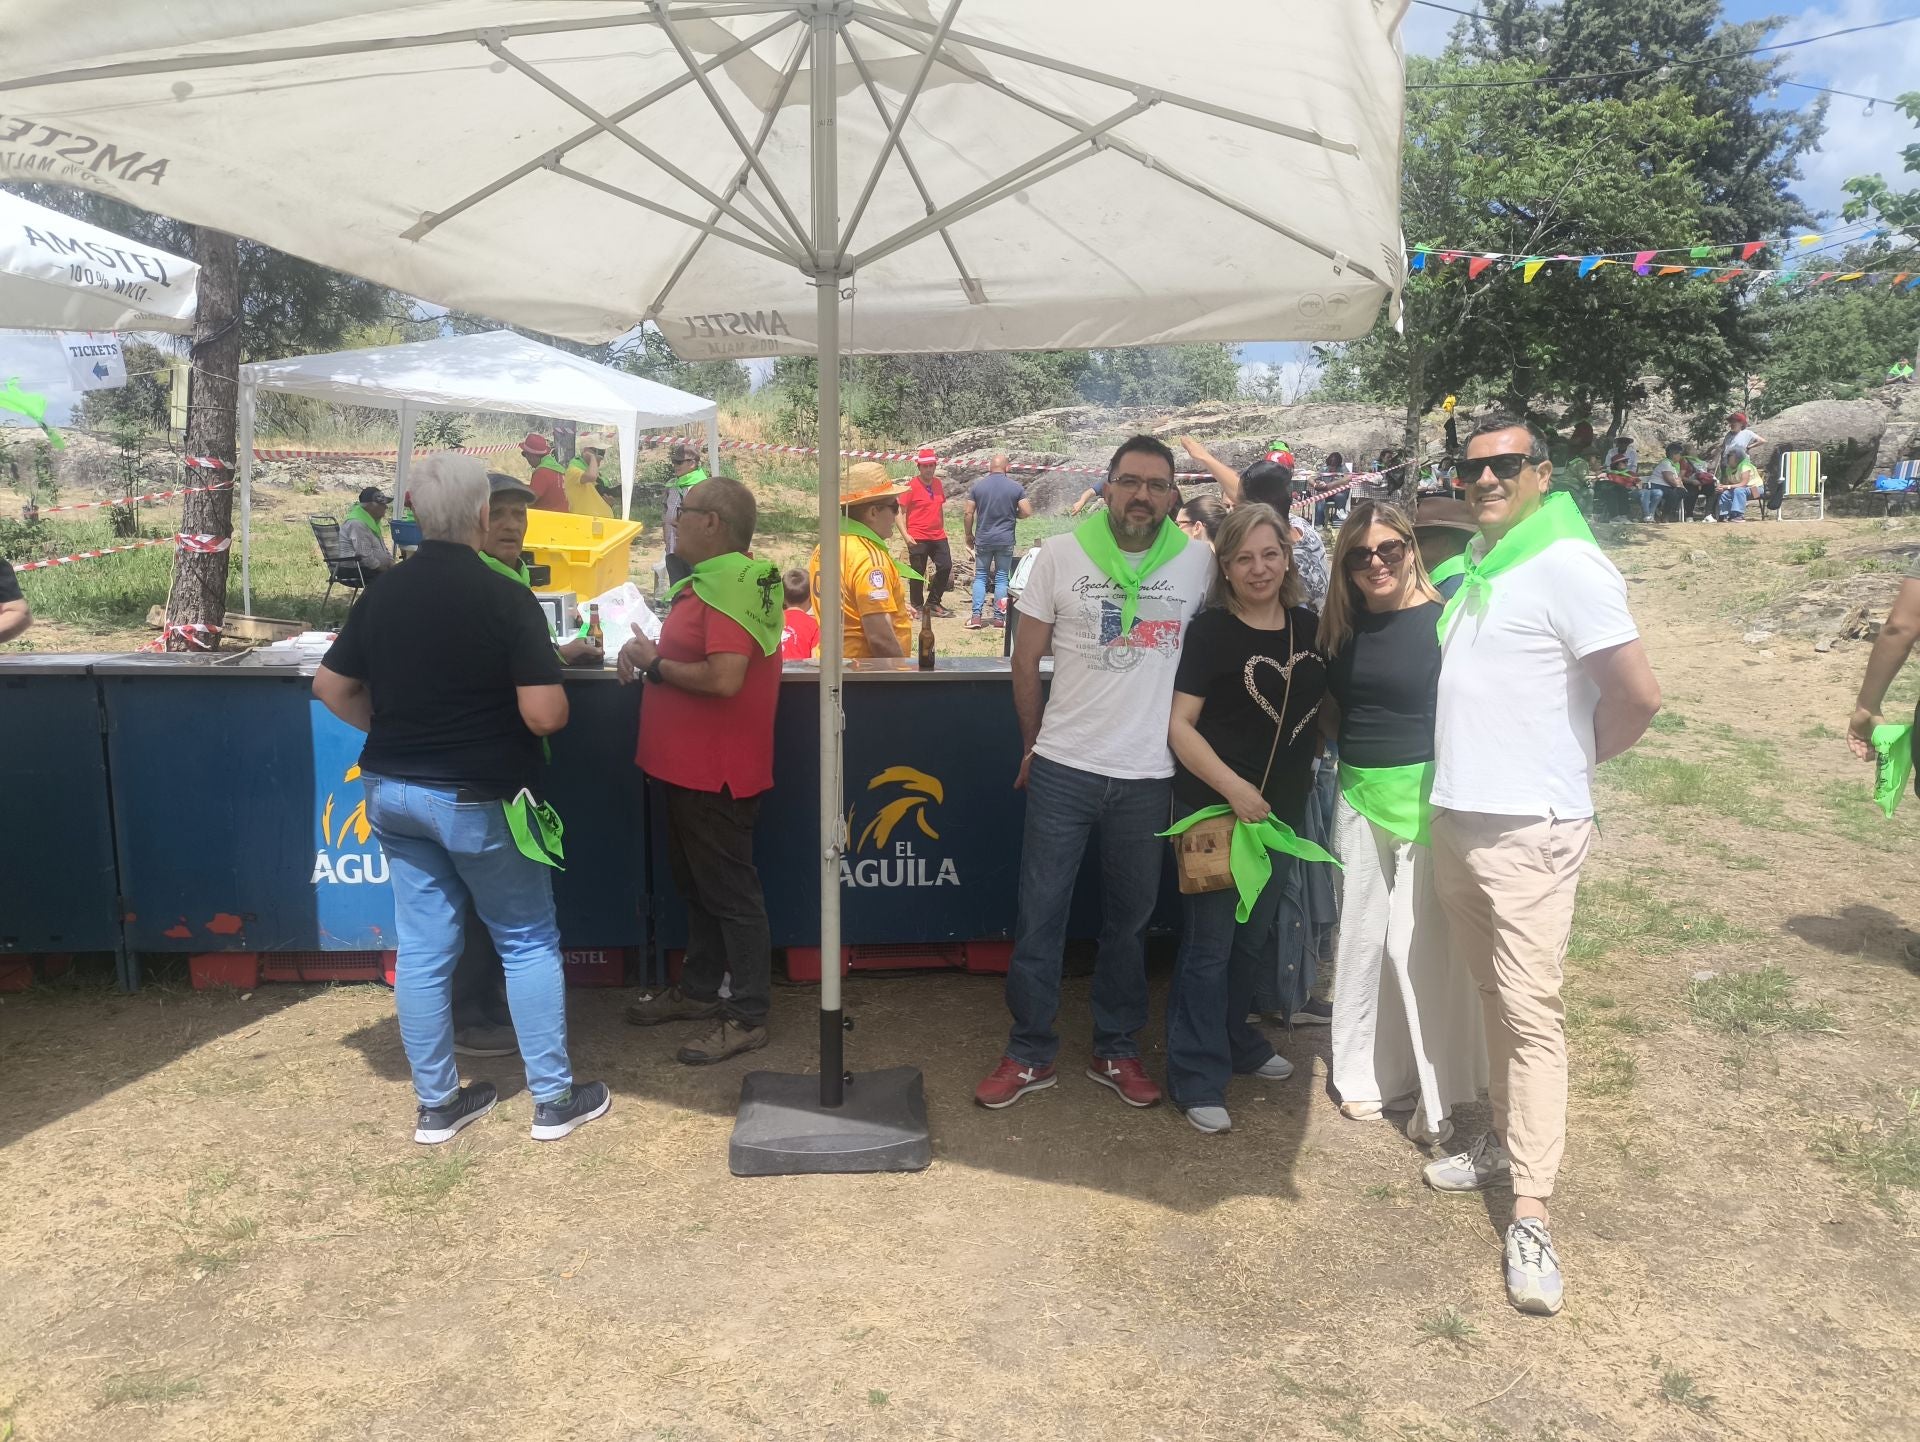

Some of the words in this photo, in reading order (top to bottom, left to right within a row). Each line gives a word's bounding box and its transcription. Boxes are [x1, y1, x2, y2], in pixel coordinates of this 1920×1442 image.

[23, 225, 173, 288] AMSTEL
[71, 264, 110, 290] 100%
[69, 343, 119, 358] TICKETS
[1072, 575, 1113, 594] Czech
[894, 841, 916, 857] EL
[310, 849, 391, 884] ÁGU
[839, 855, 961, 888] ÁGUILA
